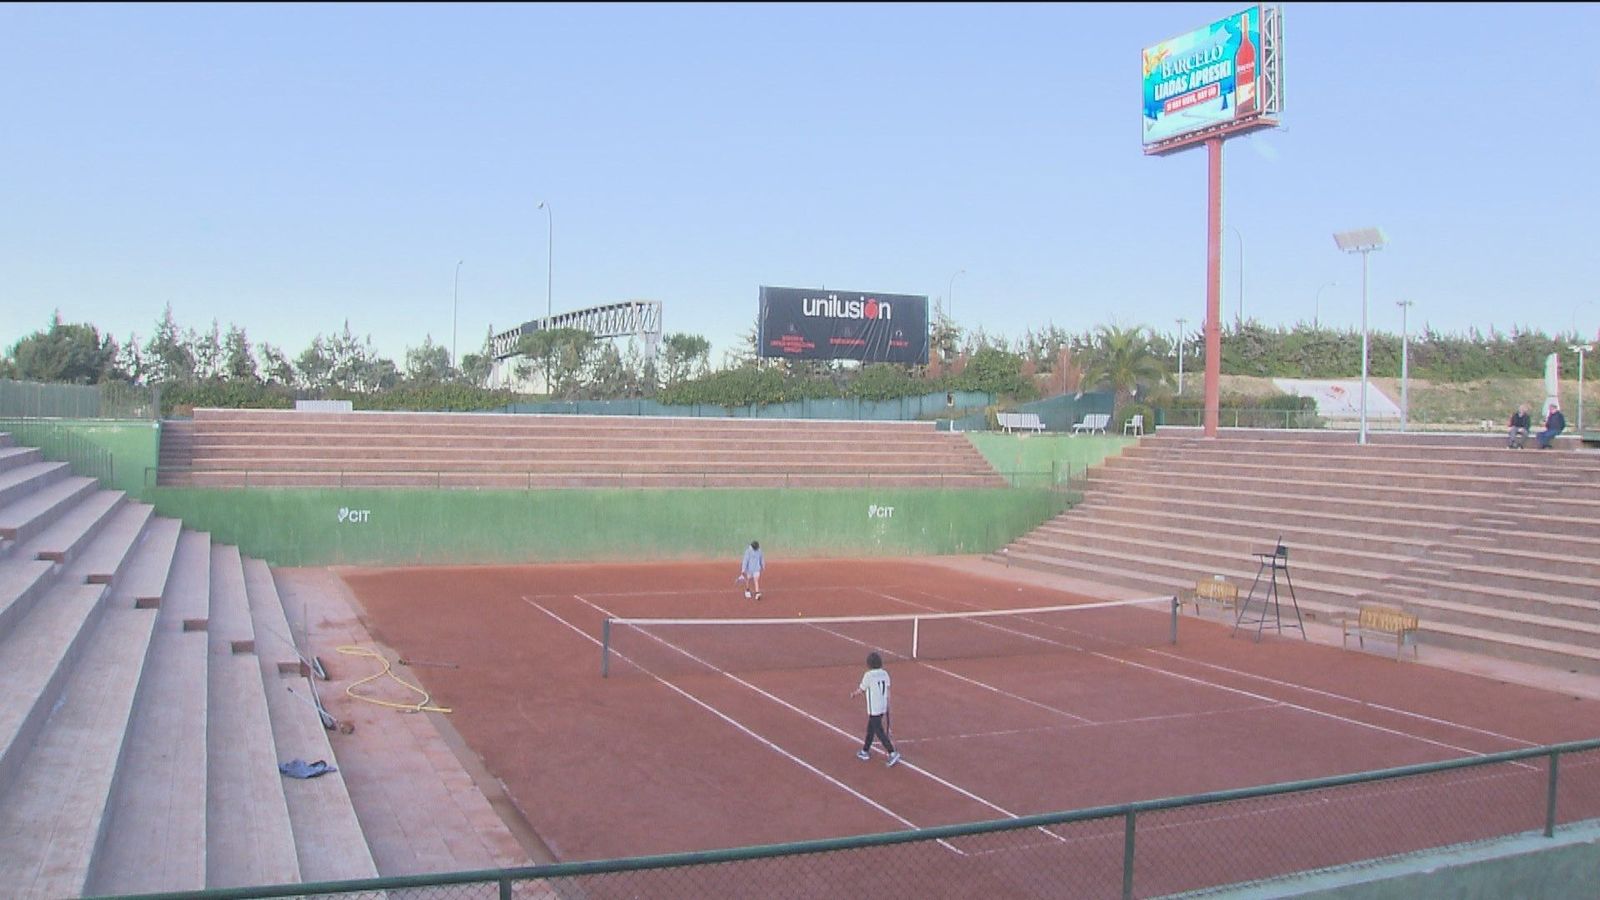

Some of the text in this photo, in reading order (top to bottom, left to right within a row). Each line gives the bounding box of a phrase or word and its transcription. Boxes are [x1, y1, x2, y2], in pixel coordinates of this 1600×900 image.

[1154, 76, 1188, 101] LIADAS
[349, 509, 371, 523] CIT
[877, 506, 895, 518] CIT
